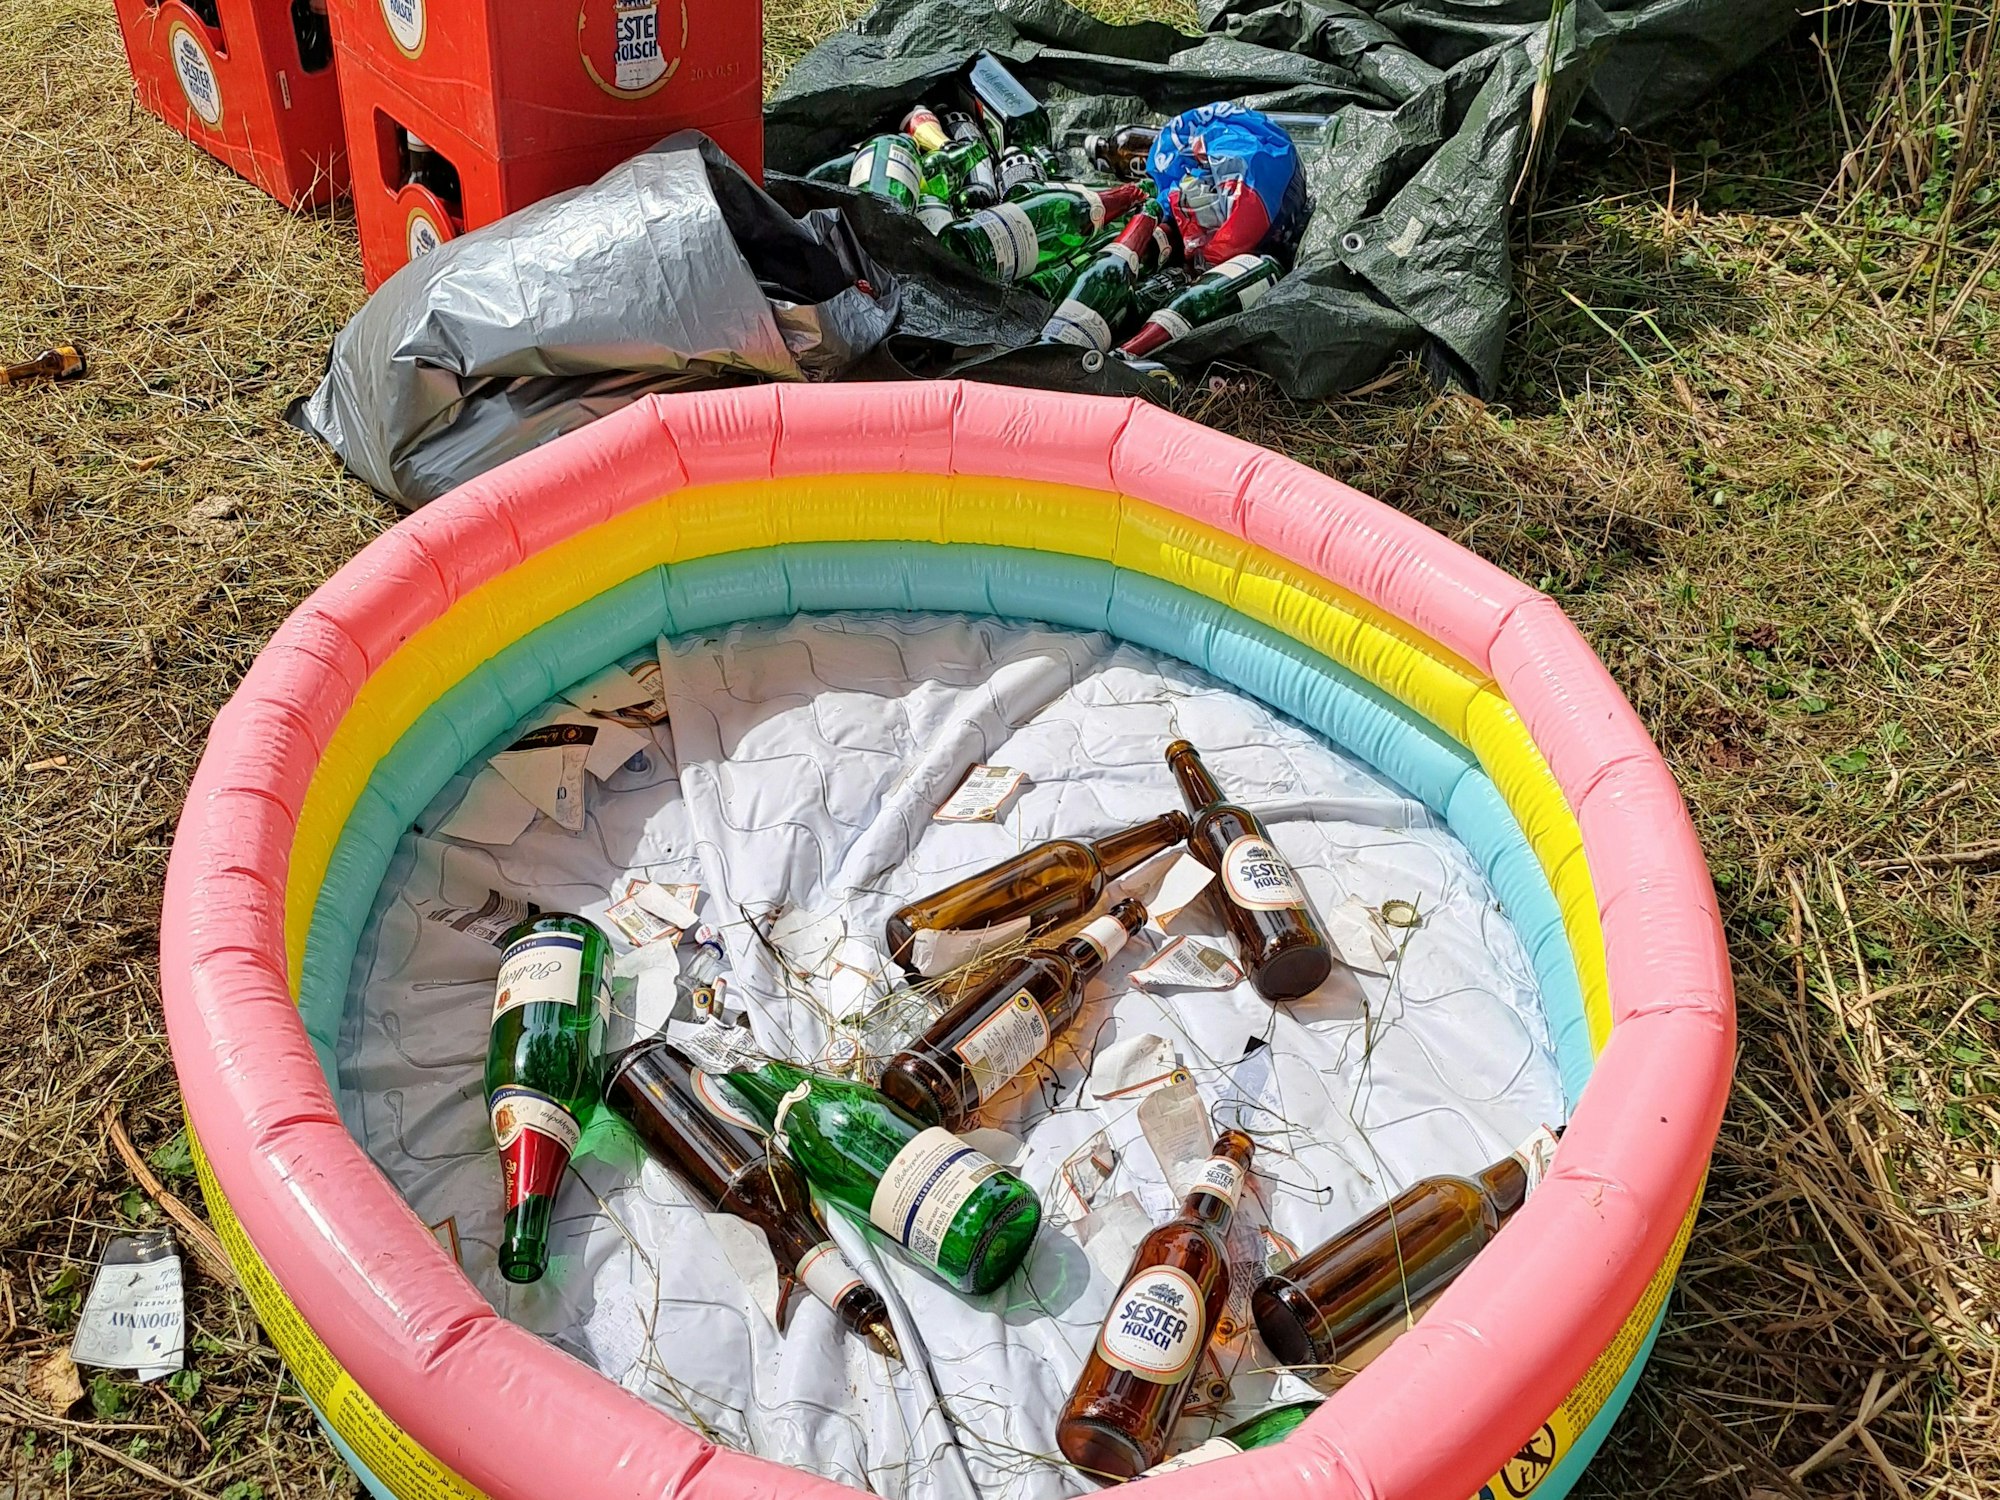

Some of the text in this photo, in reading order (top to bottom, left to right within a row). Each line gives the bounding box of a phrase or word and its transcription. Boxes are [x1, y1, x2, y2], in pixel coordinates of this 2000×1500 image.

[616, 13, 659, 42] ESTE
[180, 55, 213, 94] SESTER
[1240, 862, 1292, 882] SESTER
[1253, 876, 1293, 889] KÖLSCH
[915, 1161, 951, 1207] HALBTROCKEN
[1204, 1168, 1235, 1188] SESTER
[1120, 1299, 1188, 1344] SESTER
[1121, 1321, 1172, 1351] KÖLSCH
